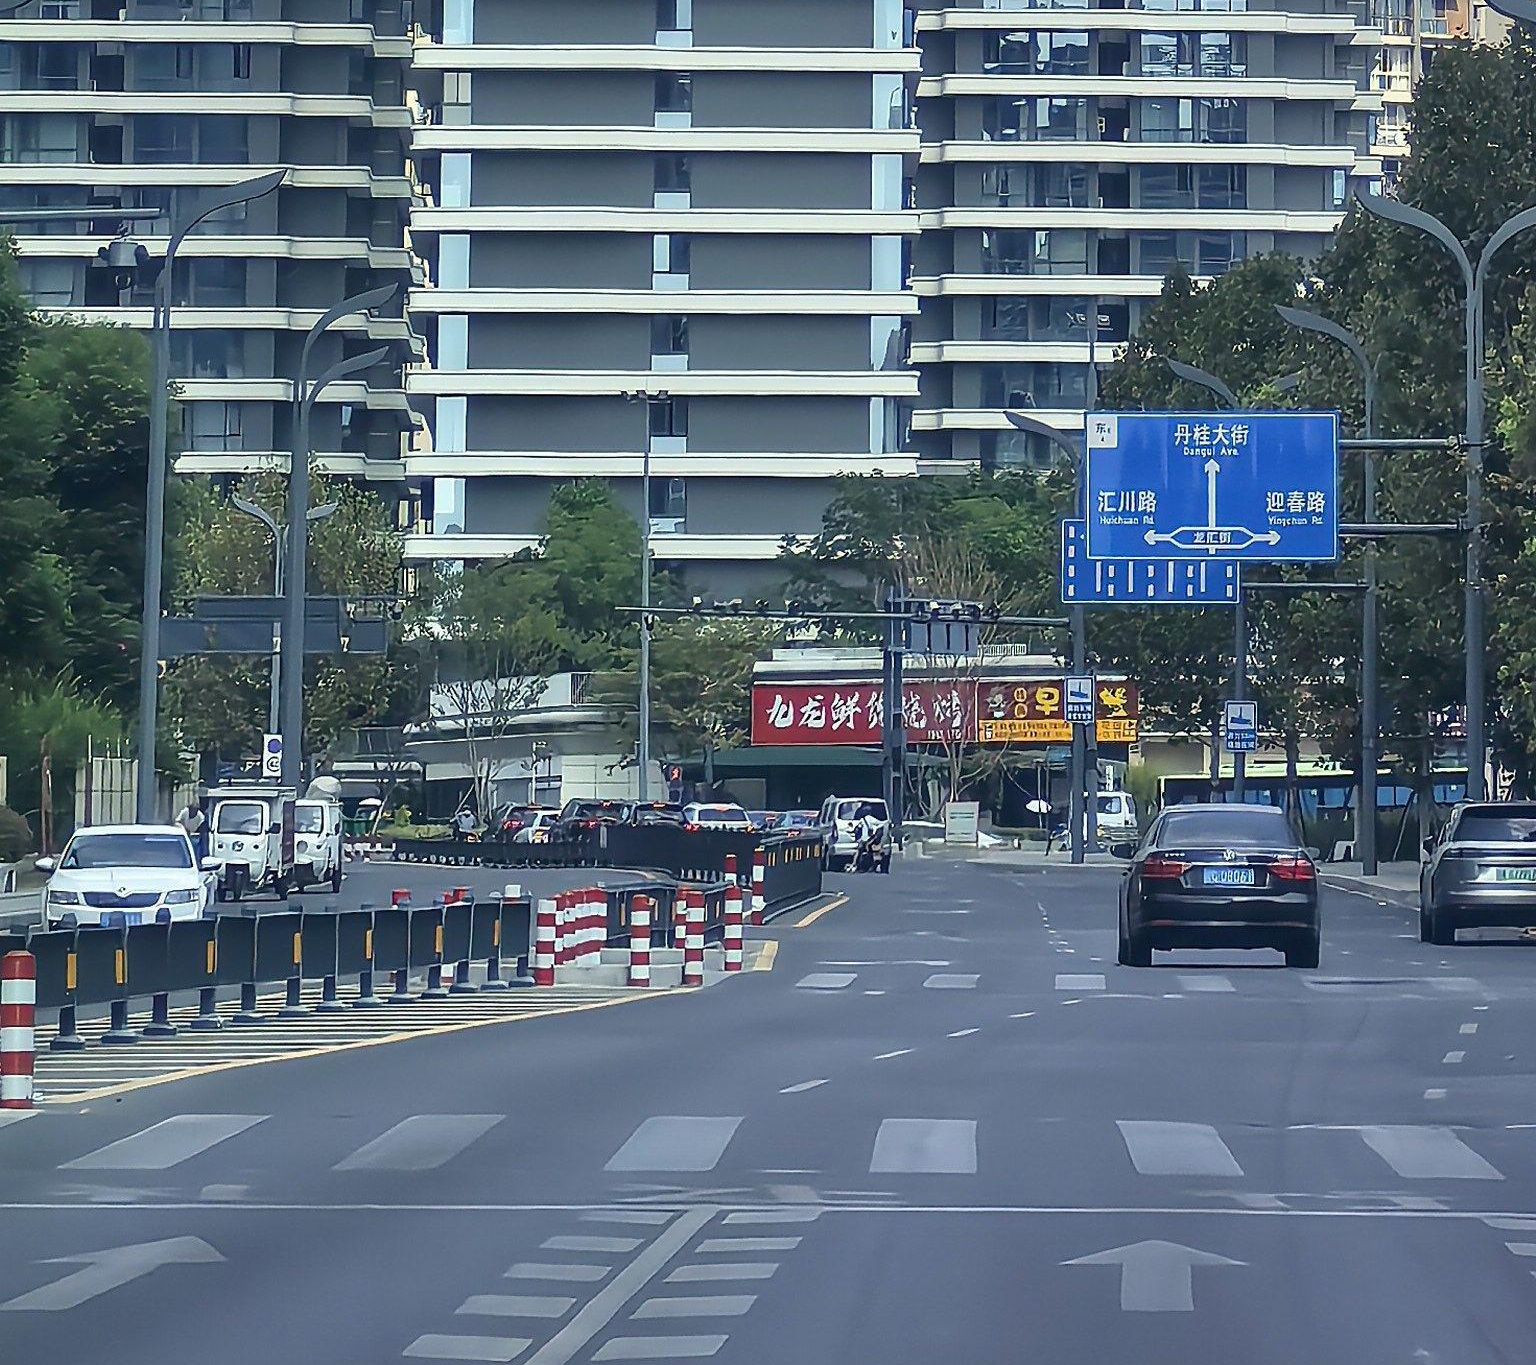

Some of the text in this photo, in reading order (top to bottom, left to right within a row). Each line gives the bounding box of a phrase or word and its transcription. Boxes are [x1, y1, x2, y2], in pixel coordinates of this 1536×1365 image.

[1174, 423, 1249, 446] 丹桂大街
[1097, 490, 1157, 513] 汇川路
[1266, 490, 1326, 513] 迎春路
